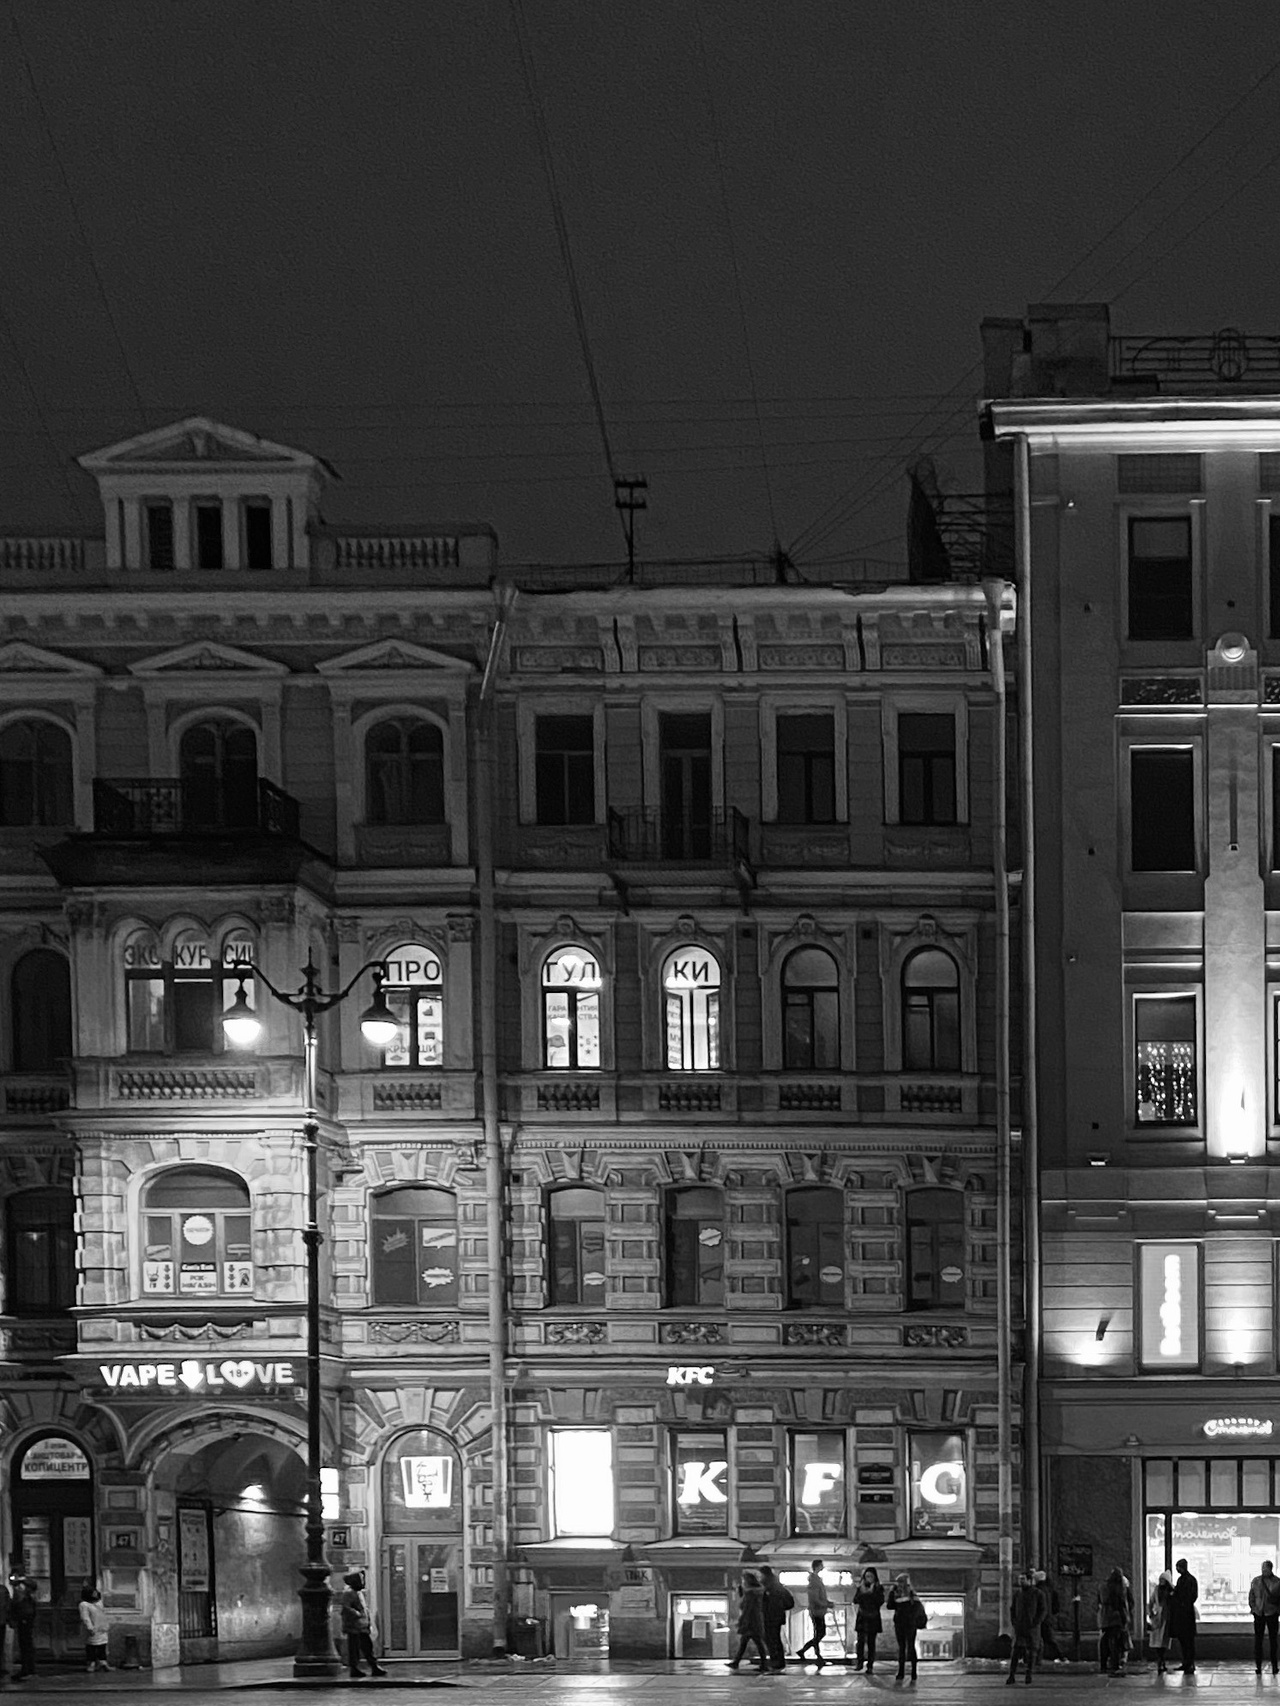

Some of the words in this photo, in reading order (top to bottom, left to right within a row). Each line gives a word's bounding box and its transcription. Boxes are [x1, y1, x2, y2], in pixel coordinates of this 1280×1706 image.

[385, 960, 440, 982] ПРО
[546, 961, 596, 983] ГУЛ
[674, 961, 709, 983] КИ
[100, 1364, 176, 1387] VAPE
[666, 1366, 714, 1385] KFC
[24, 1462, 88, 1473] КОПИЦЕНТР
